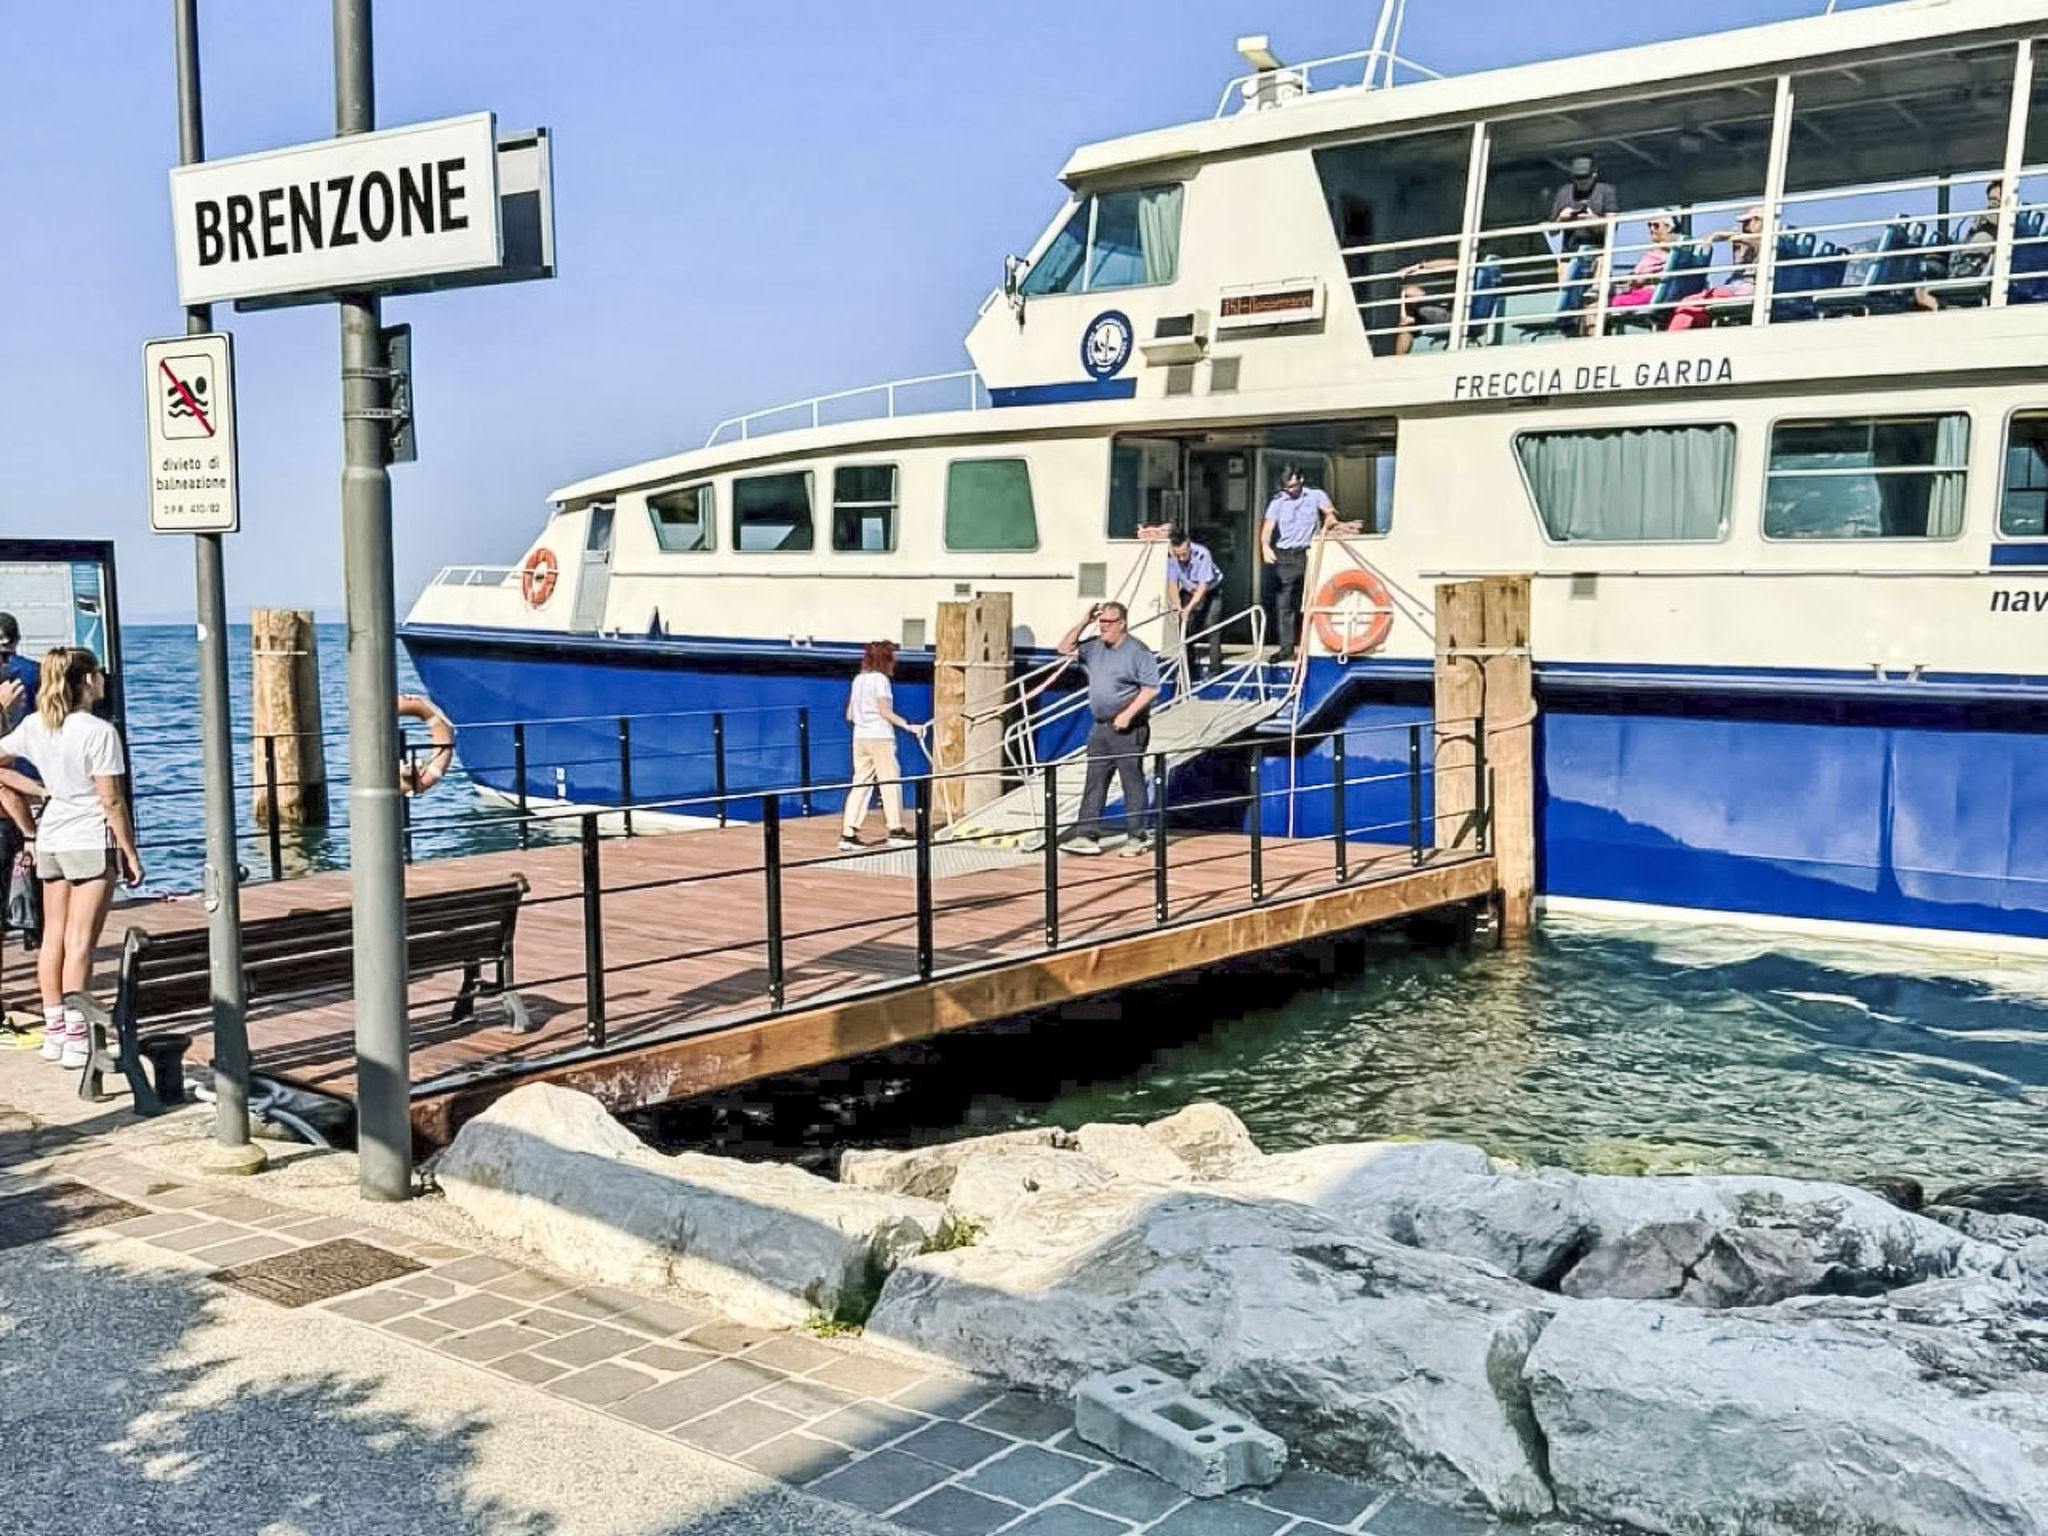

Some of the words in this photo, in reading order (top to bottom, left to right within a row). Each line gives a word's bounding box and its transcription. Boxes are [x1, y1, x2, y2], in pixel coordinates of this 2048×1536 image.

[195, 157, 469, 266] BRENZONE
[1454, 368, 1562, 399] FRECCIA
[1575, 365, 1622, 390] DEL
[1635, 357, 1733, 386] GARDA
[162, 457, 201, 471] divieto
[208, 454, 220, 469] di
[156, 476, 226, 490] balneazione
